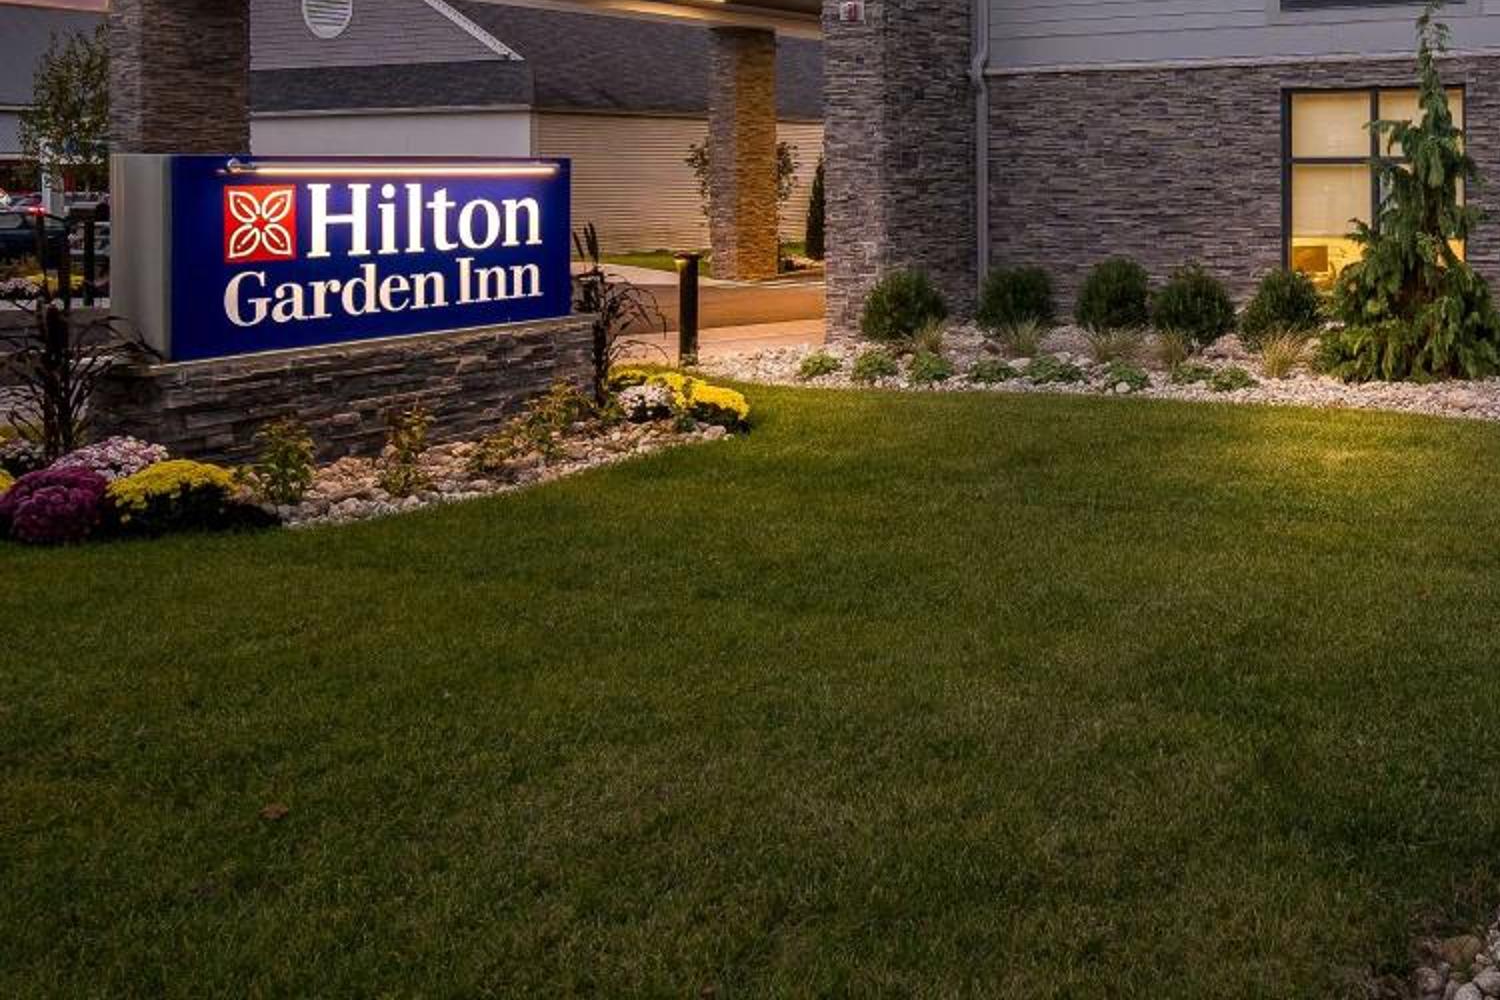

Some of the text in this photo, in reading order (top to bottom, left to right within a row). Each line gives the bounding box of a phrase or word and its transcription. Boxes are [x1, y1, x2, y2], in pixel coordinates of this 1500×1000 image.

[307, 182, 542, 259] Hilton
[223, 257, 544, 328] Garden Inn
